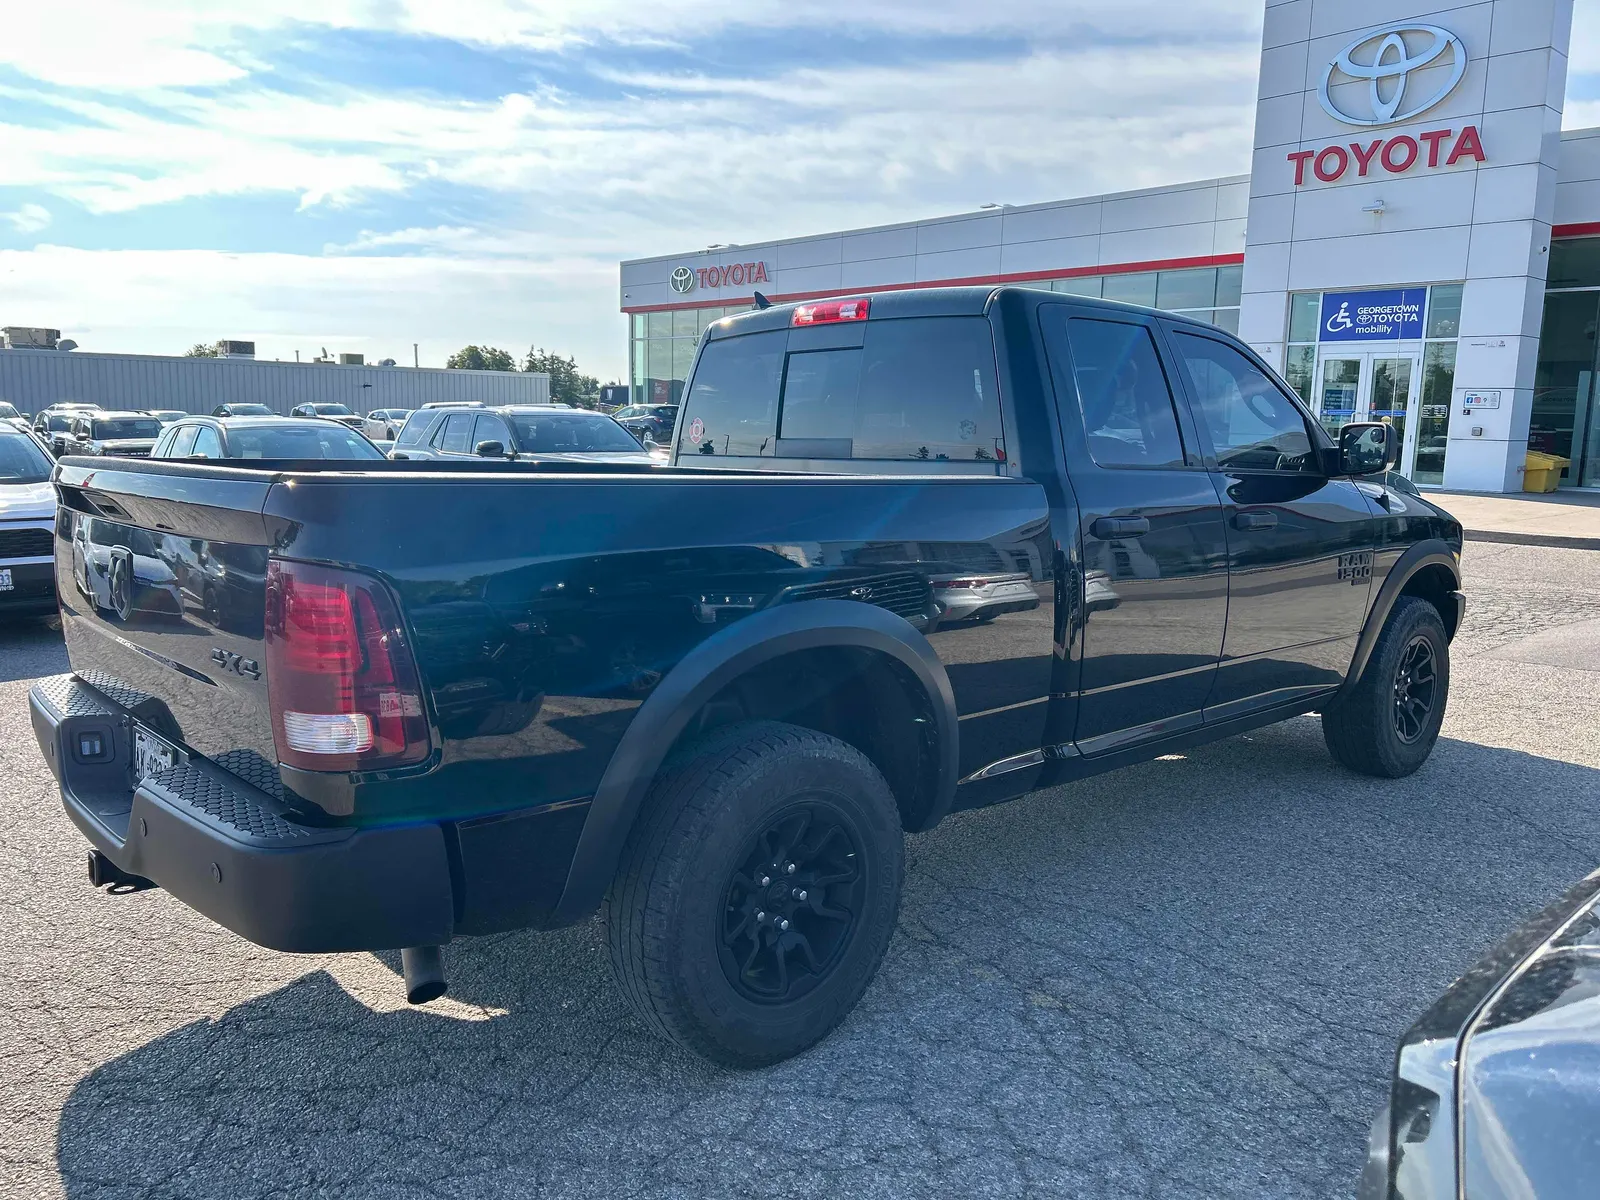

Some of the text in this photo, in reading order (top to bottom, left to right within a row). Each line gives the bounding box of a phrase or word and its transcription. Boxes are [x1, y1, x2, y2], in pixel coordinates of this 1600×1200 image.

[1286, 125, 1487, 186] TOYOTA
[696, 261, 769, 288] TOYOTA
[1357, 304, 1419, 315] GEORGETOWN
[1372, 313, 1419, 323] TOYOTA
[1355, 324, 1393, 335] mobility
[1338, 553, 1372, 567] RAM
[1337, 565, 1372, 580] 1500
